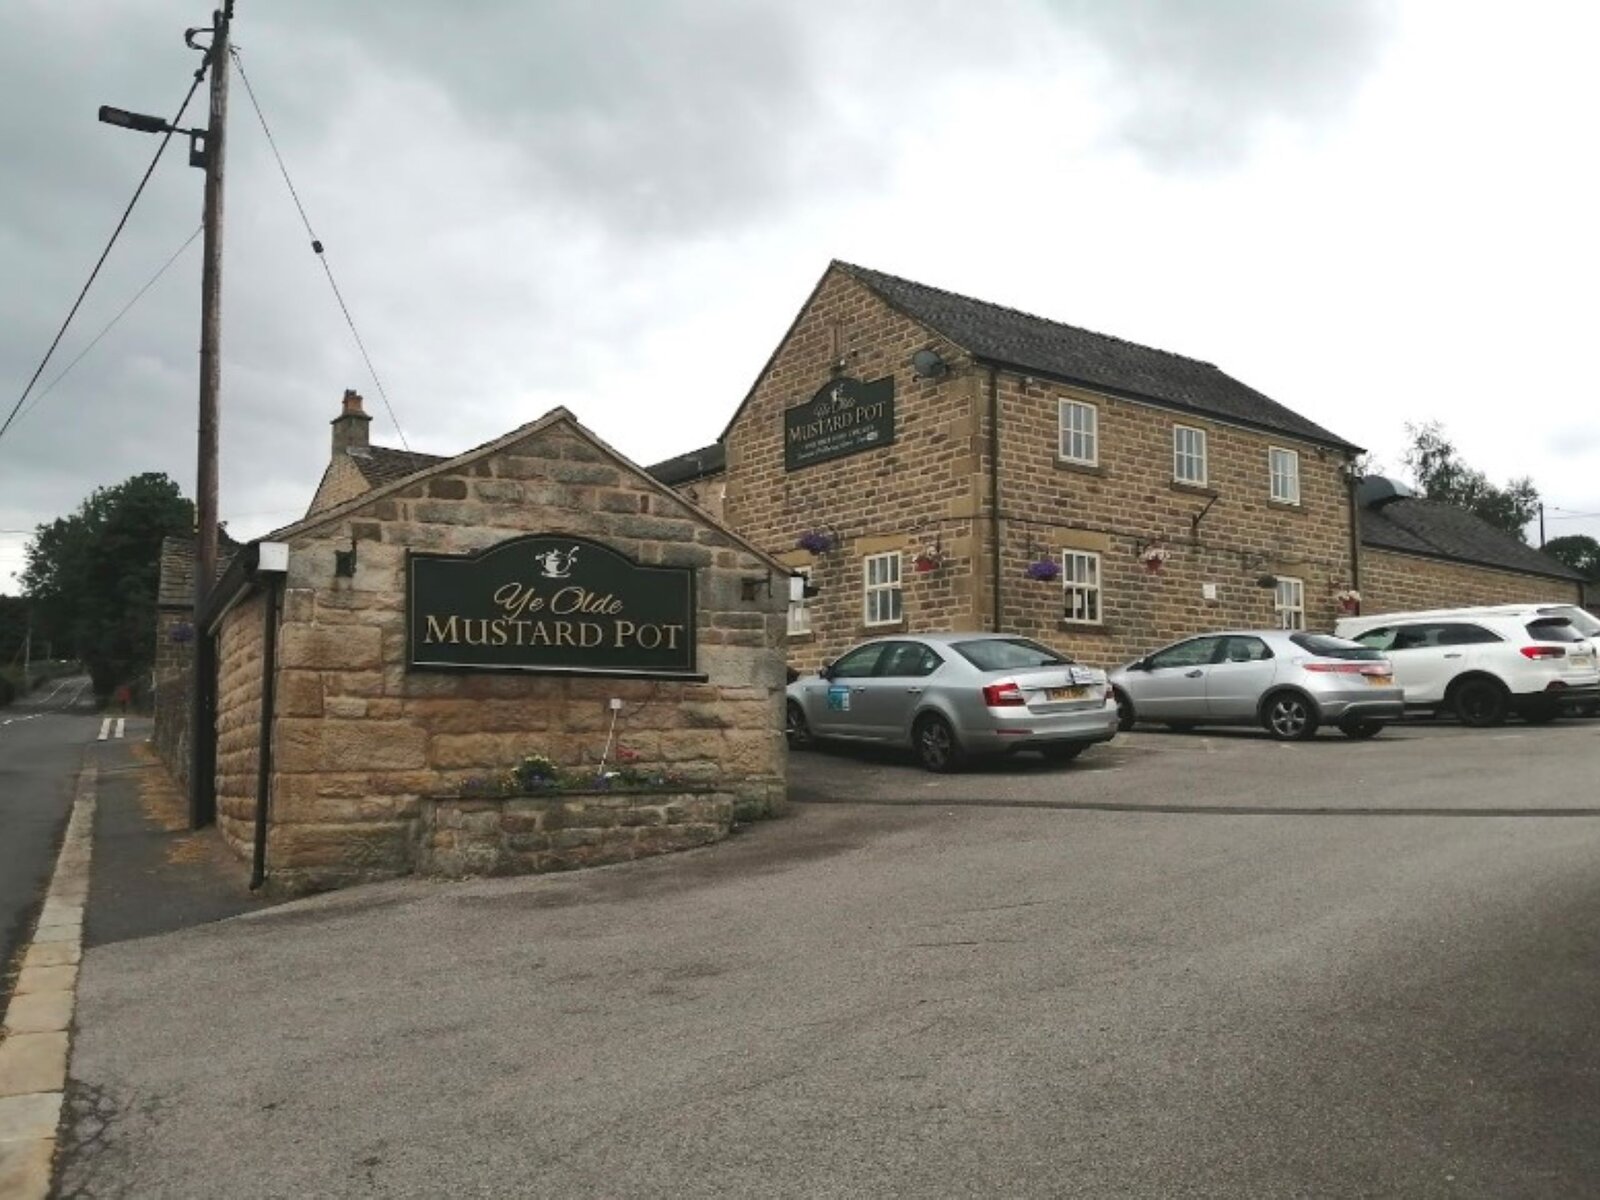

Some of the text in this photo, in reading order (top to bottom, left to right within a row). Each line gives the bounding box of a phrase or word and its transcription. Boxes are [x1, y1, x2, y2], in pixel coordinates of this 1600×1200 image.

[789, 412, 853, 441] MUSTARD
[856, 401, 886, 424] POT
[493, 582, 623, 620] Ye Olde
[423, 615, 683, 650] MUSTARD POT
